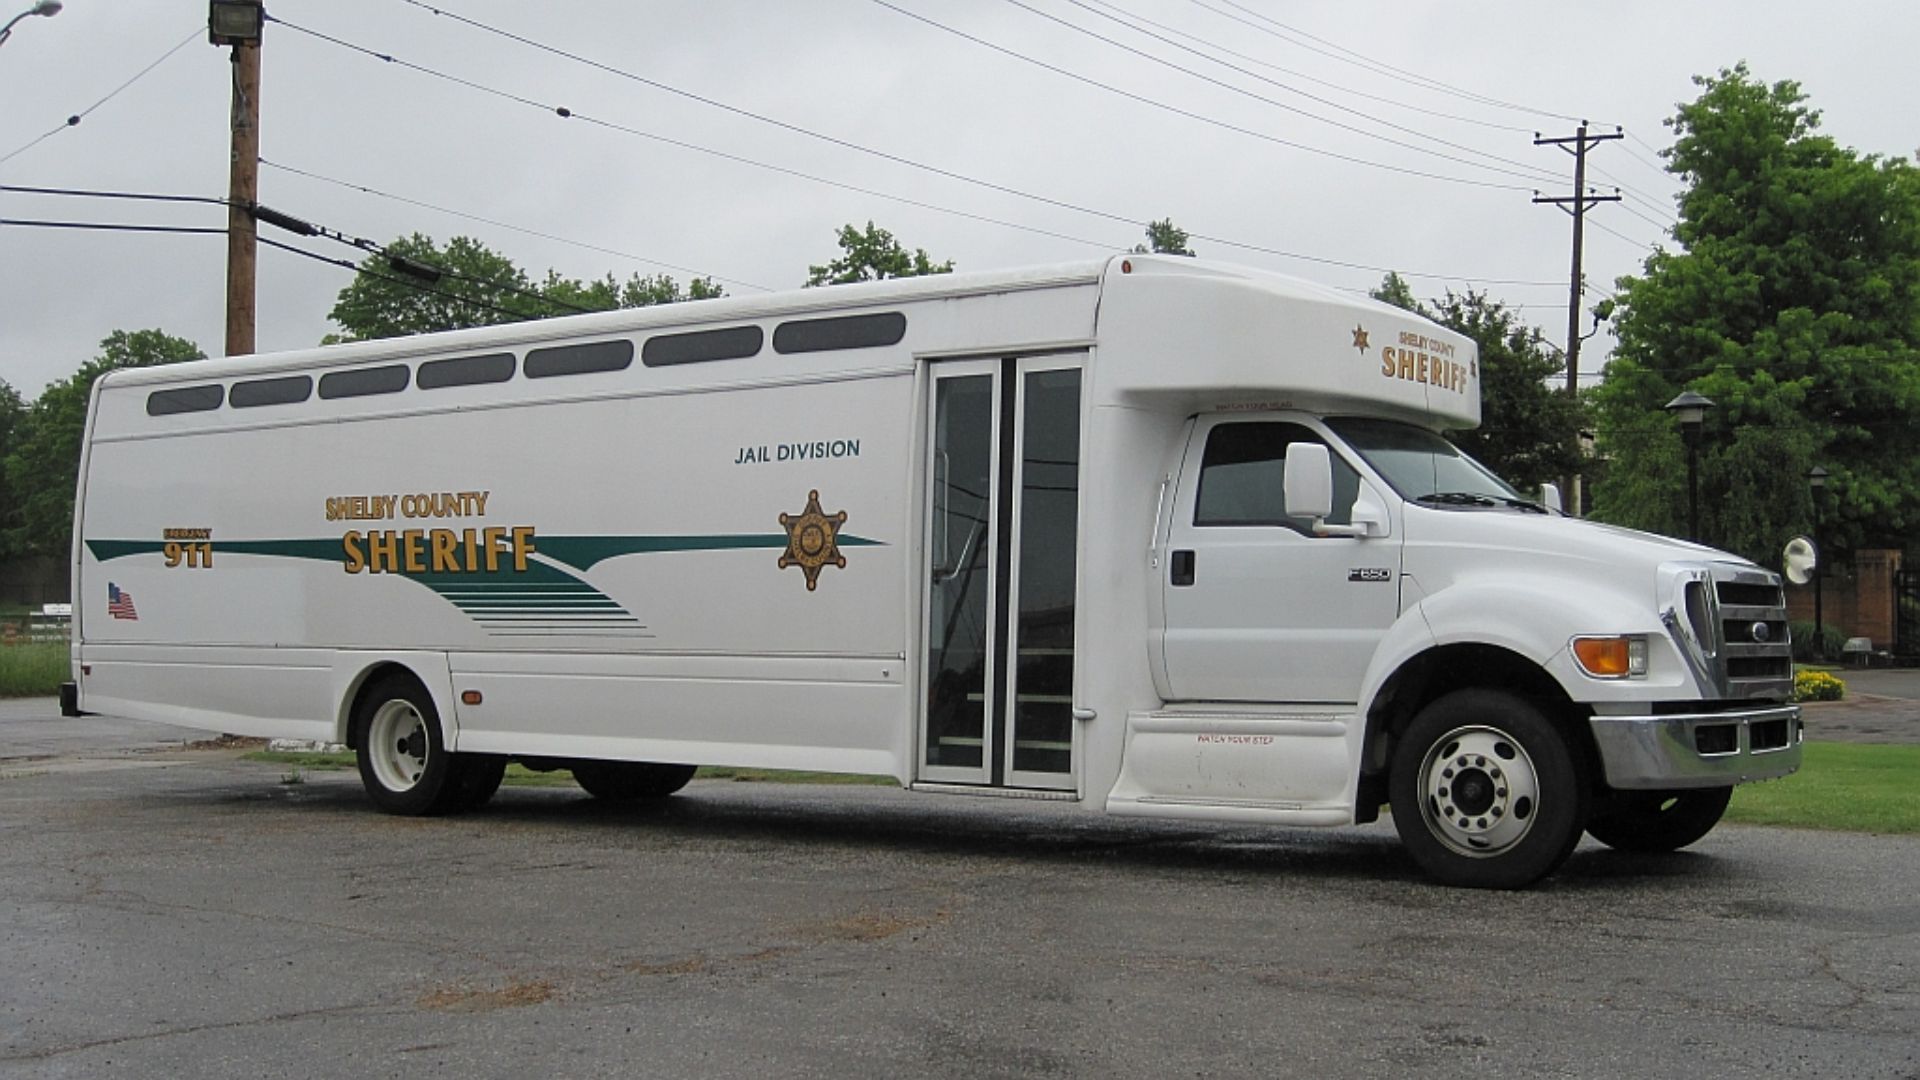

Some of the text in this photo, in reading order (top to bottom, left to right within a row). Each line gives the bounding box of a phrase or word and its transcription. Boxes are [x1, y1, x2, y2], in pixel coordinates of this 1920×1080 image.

[1399, 331, 1429, 349] SHELBY
[1381, 346, 1467, 395] SHERIFF
[734, 439, 860, 464] JAIL DIVISION
[326, 491, 490, 521] SHELBY COUNTY
[162, 541, 213, 568] 911
[343, 526, 536, 574] SHERIFF
